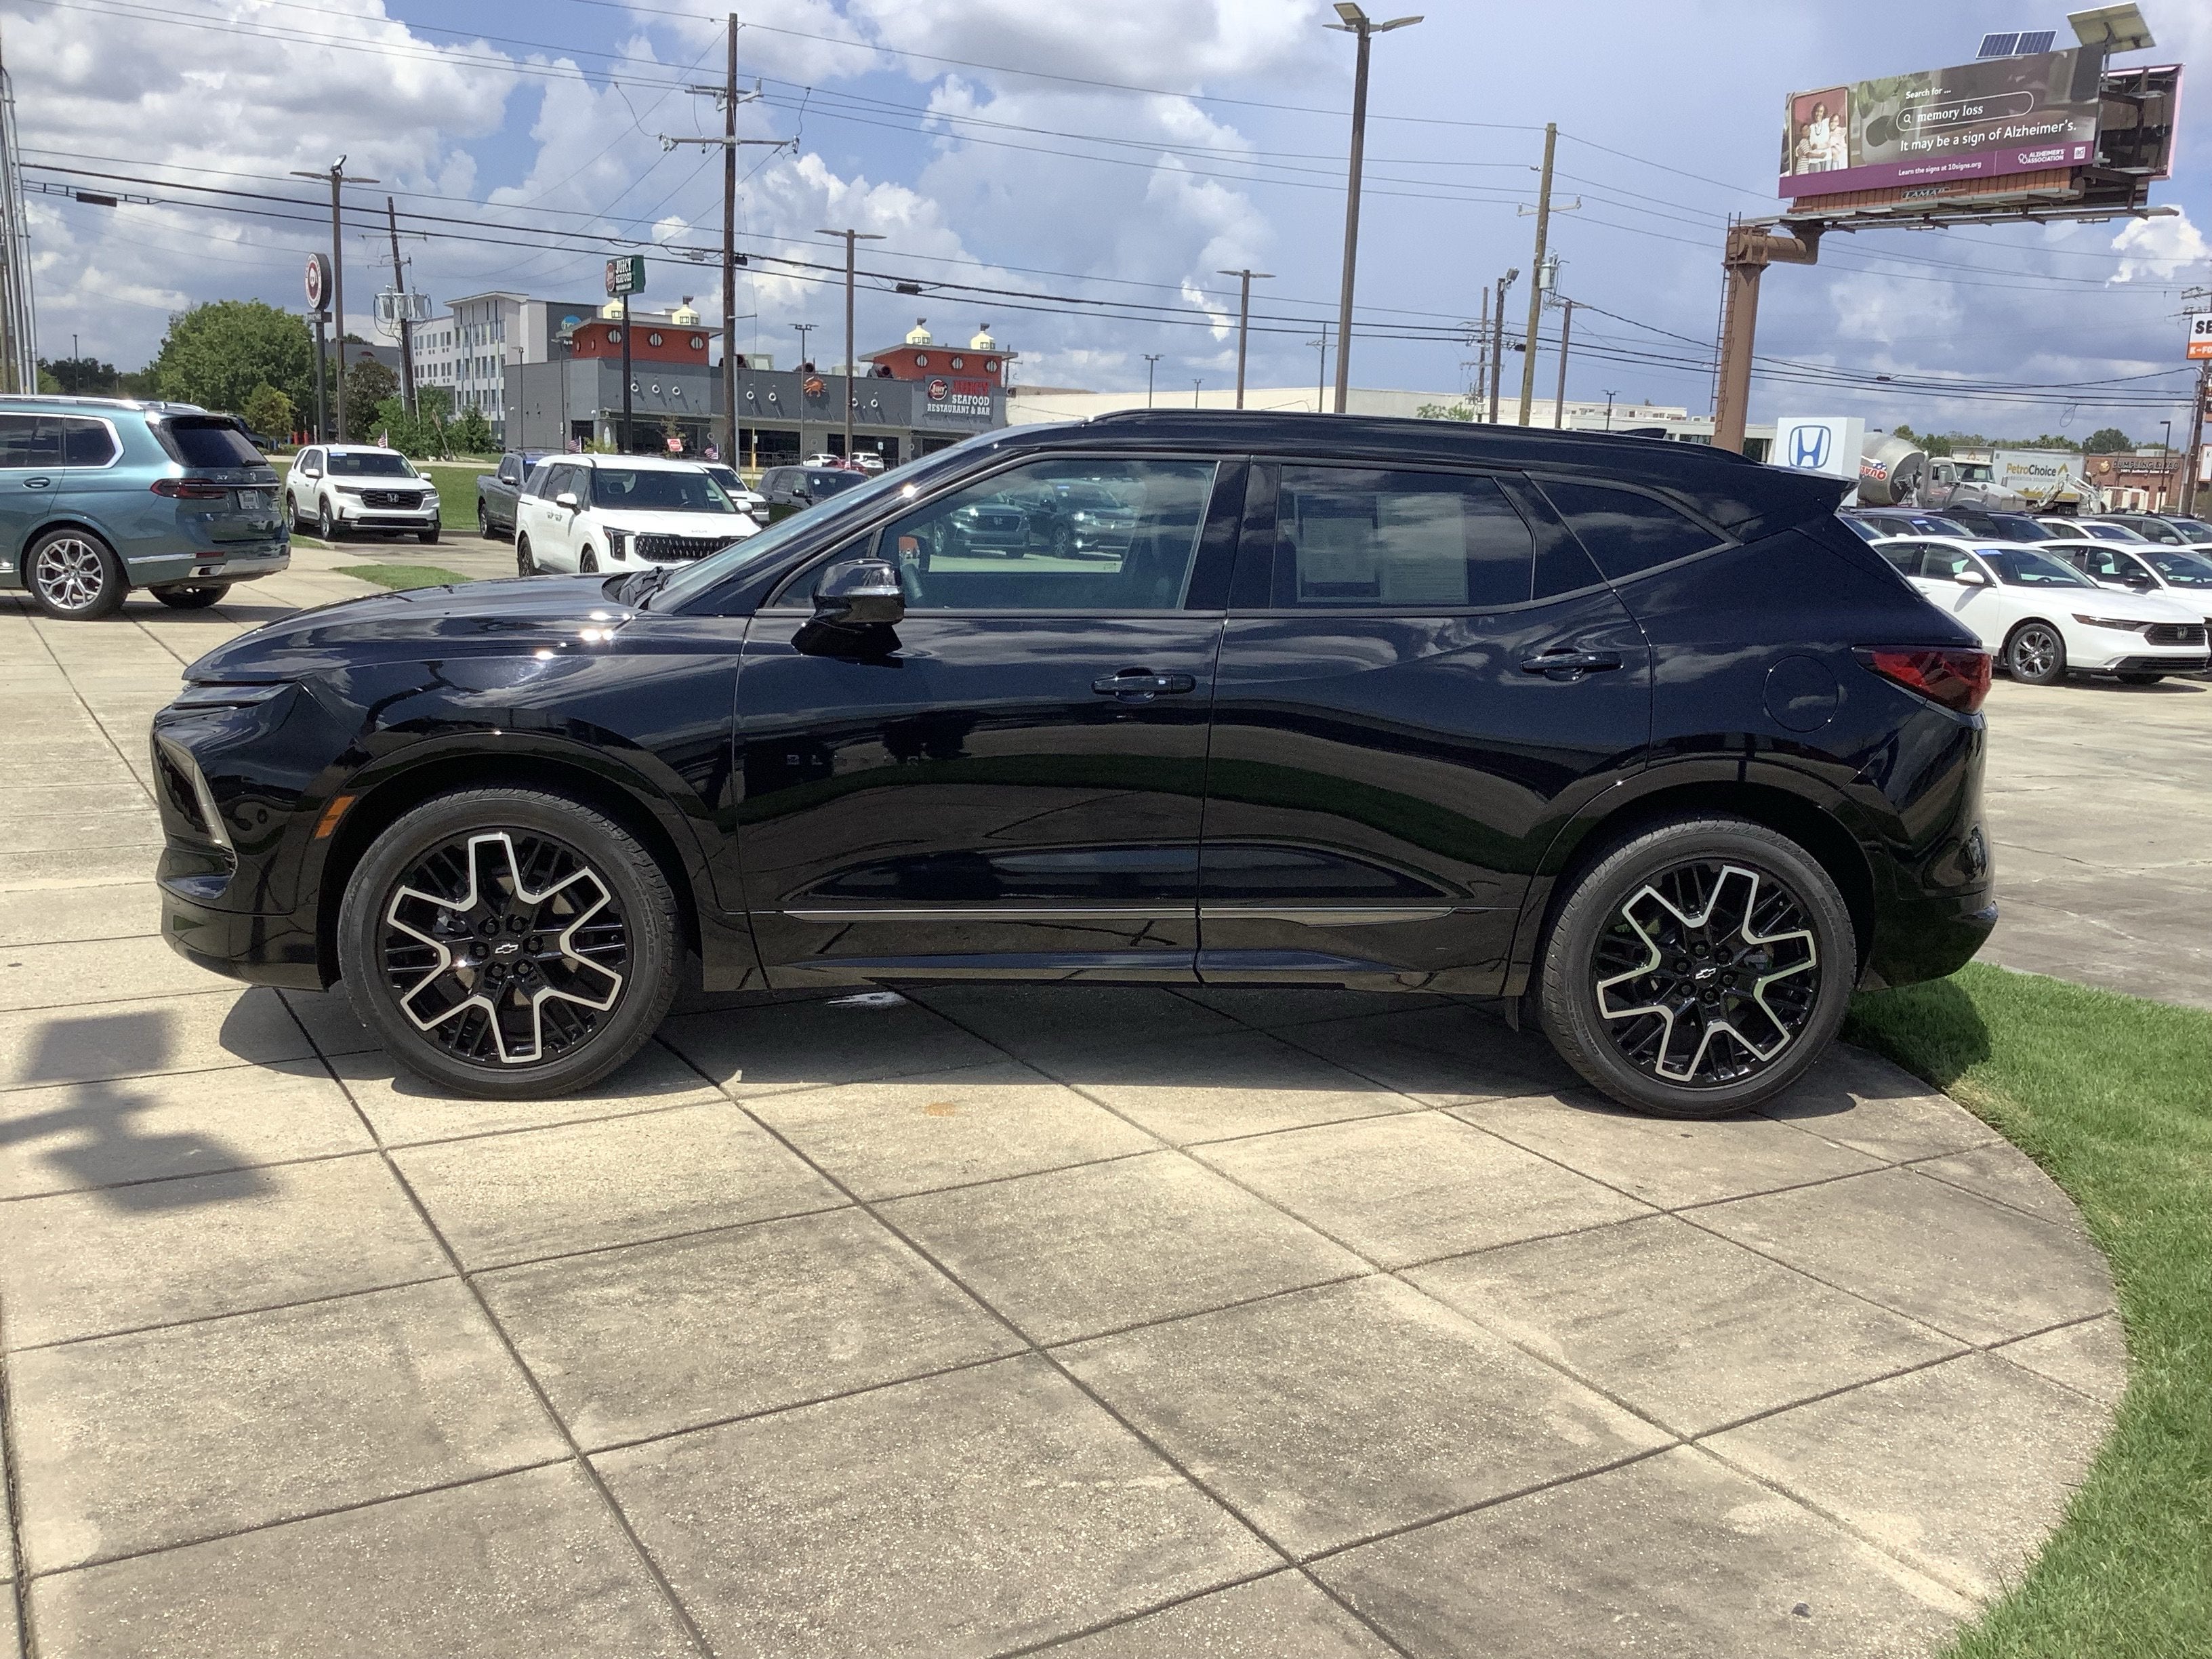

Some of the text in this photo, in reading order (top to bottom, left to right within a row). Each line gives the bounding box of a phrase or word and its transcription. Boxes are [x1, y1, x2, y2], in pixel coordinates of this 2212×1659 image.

[1906, 88, 1930, 99] Search
[1917, 105, 1984, 122] memory loss
[1900, 119, 2077, 151] It may be a sign of Alzheimer's.
[2027, 155, 2064, 163] ASSOCIATION
[1925, 165, 1940, 173] signs
[1948, 162, 1982, 171] 10signs.org
[615, 258, 632, 274] JUICY
[951, 380, 988, 395] JUICY
[952, 394, 989, 406] SEAFOOD
[927, 403, 970, 414] RESTAURANT
[977, 407, 990, 415] BAR
[2007, 463, 2056, 476] PetroChoice
[2112, 460, 2153, 469] DUMPLING
